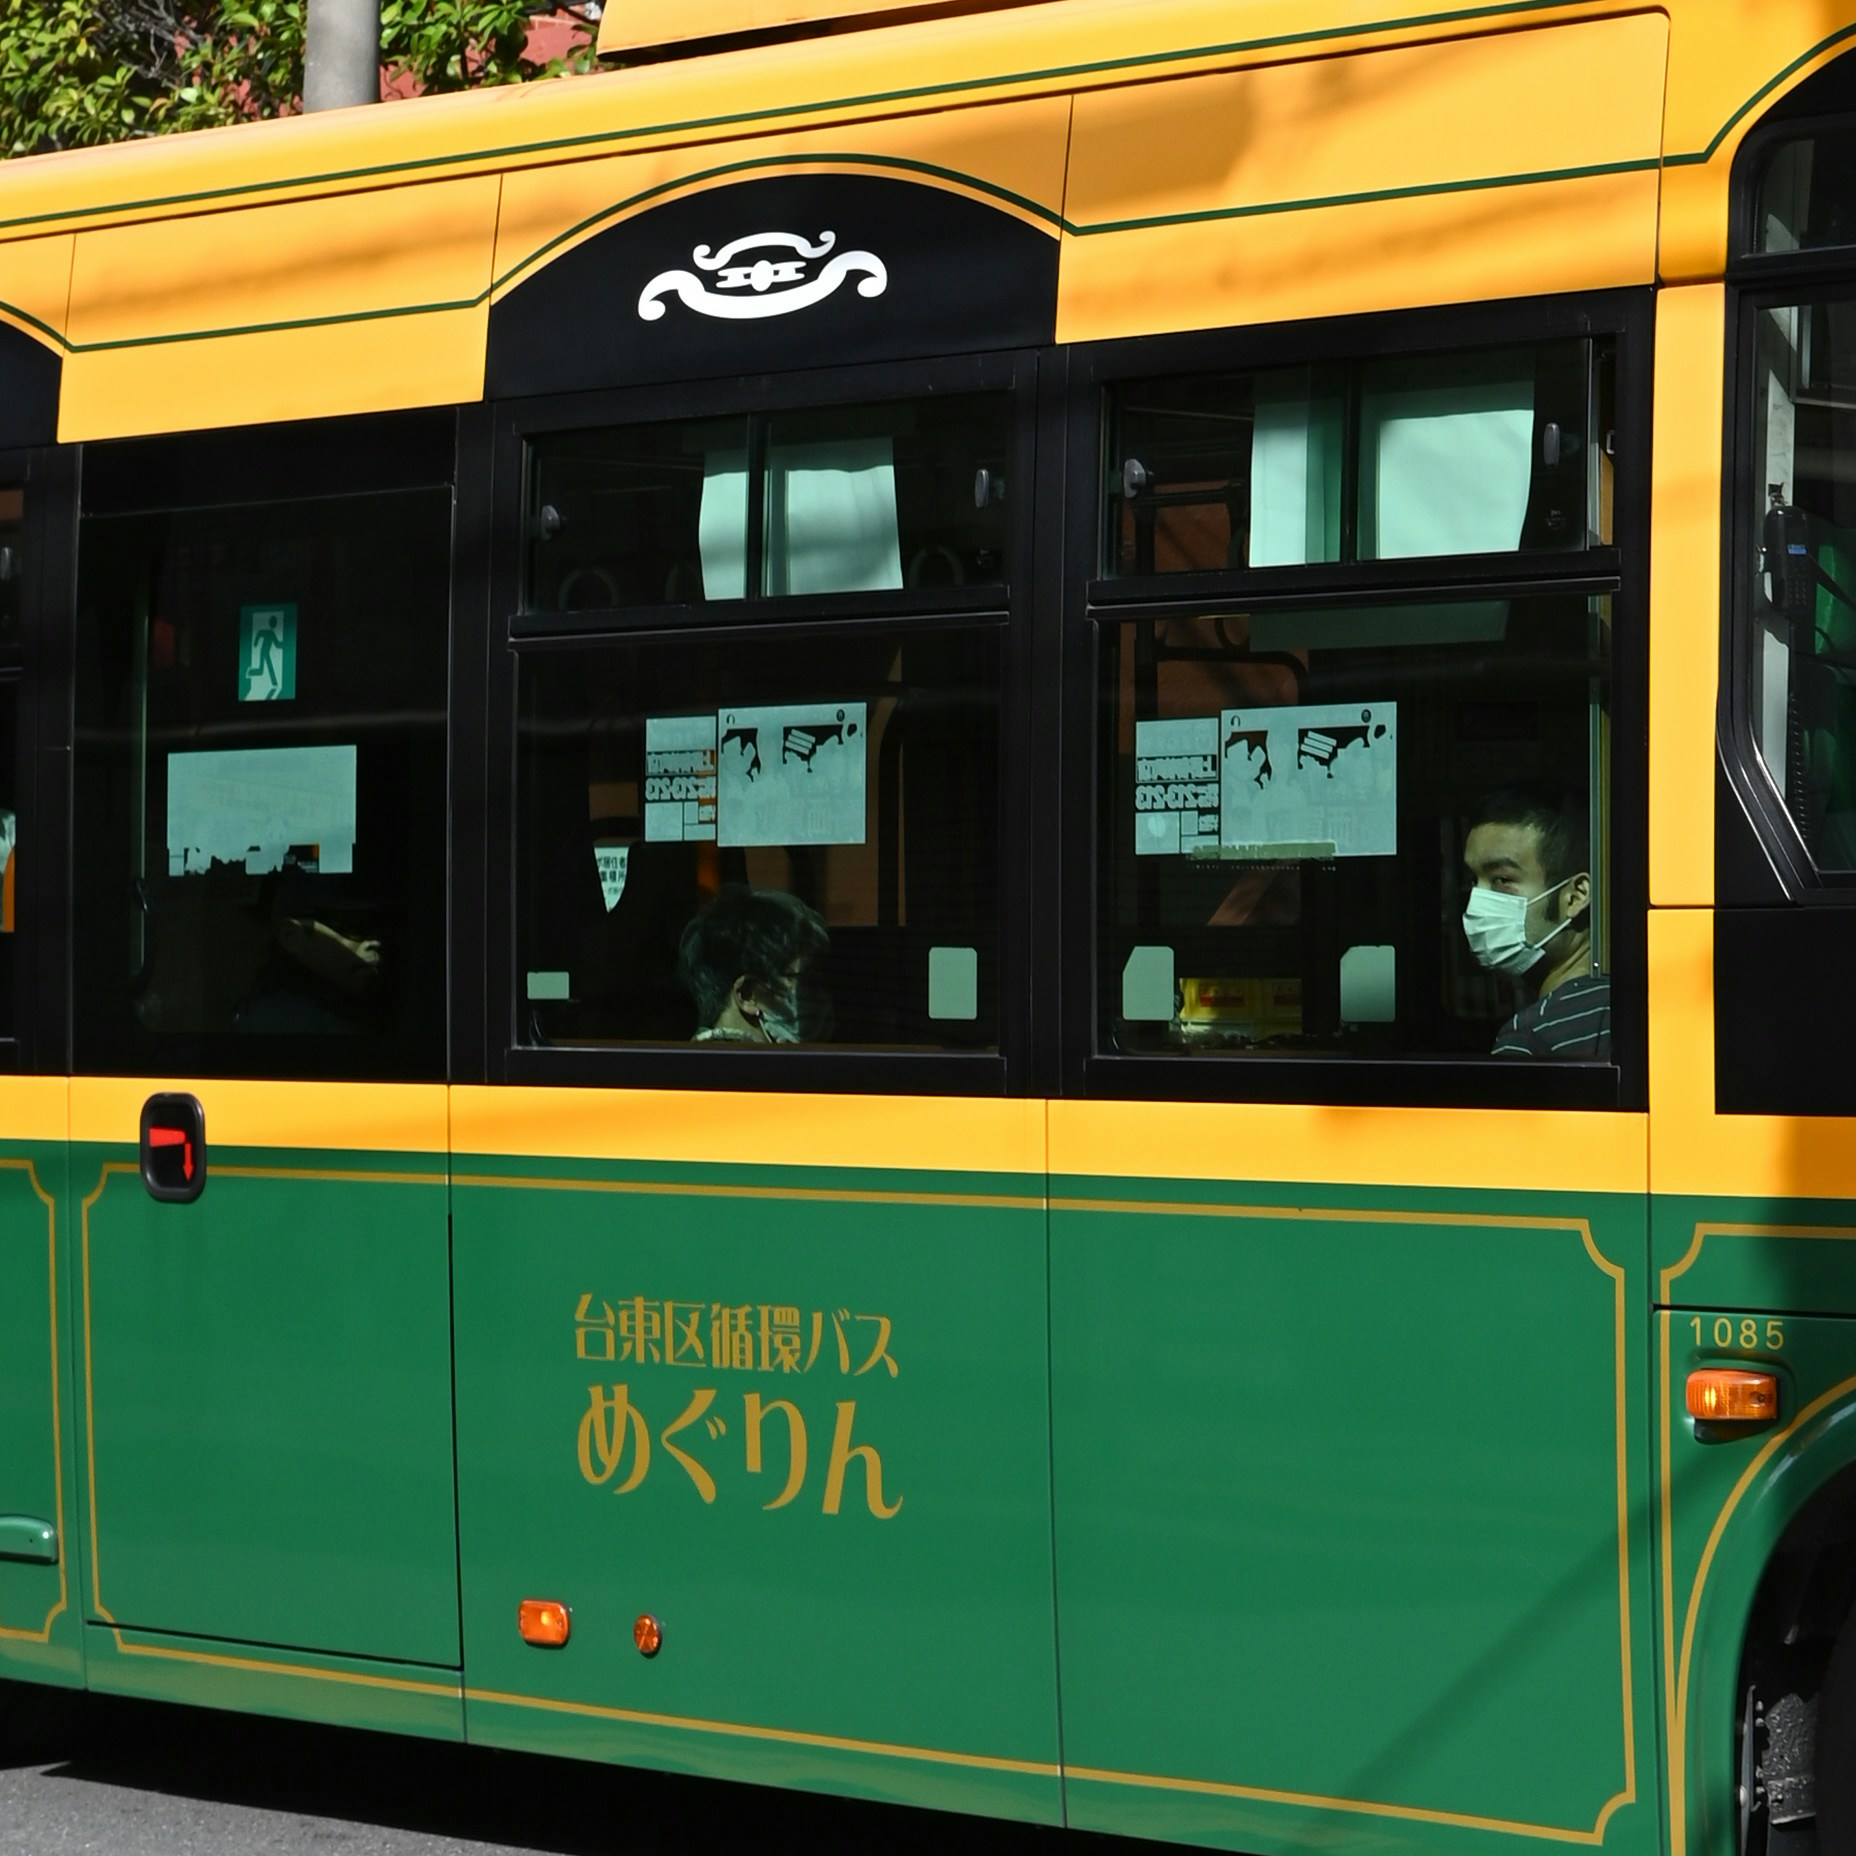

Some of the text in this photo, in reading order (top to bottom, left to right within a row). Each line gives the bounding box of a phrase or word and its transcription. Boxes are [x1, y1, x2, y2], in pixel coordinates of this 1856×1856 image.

[574, 1293, 899, 1378] 台東区循環バス
[1690, 1316, 1784, 1350] 1085
[577, 1383, 903, 1519] めぐりん
